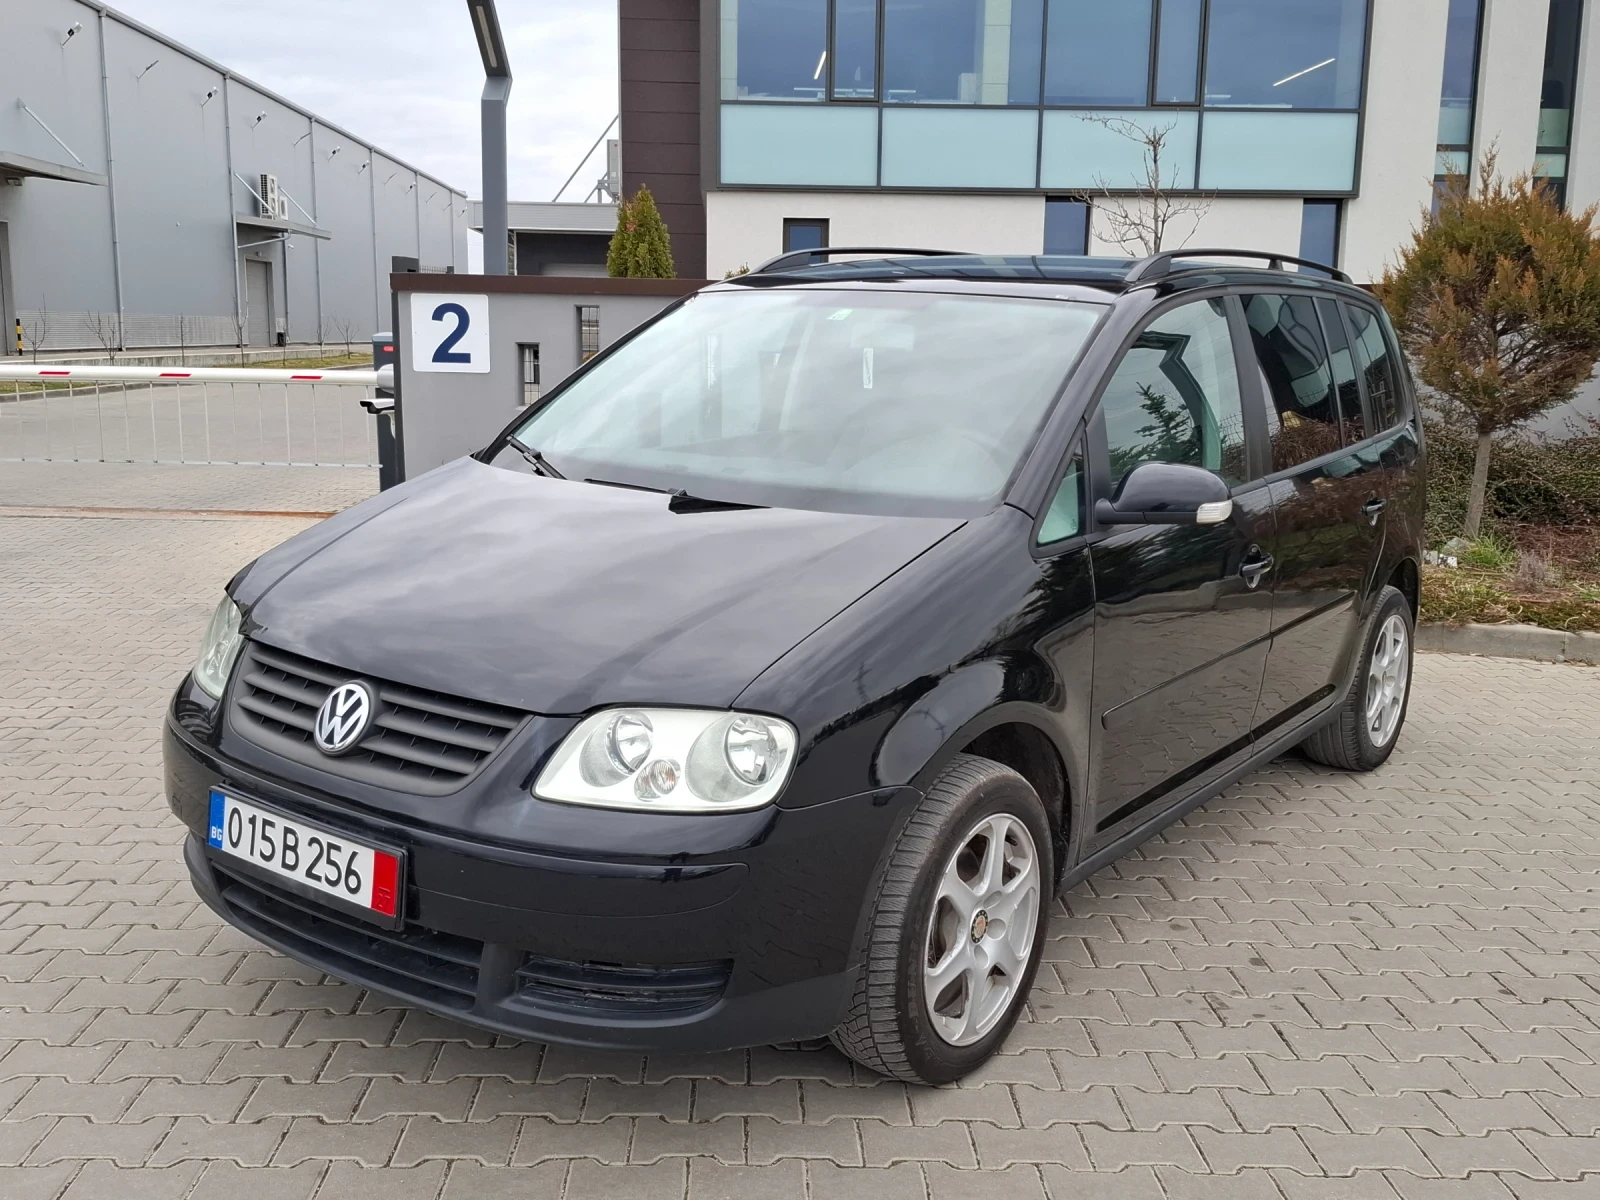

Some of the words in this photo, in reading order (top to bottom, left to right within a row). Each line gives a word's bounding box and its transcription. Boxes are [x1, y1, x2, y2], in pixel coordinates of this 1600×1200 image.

[431, 302, 472, 364] 2
[317, 685, 367, 749] VW
[211, 825, 223, 841] BG
